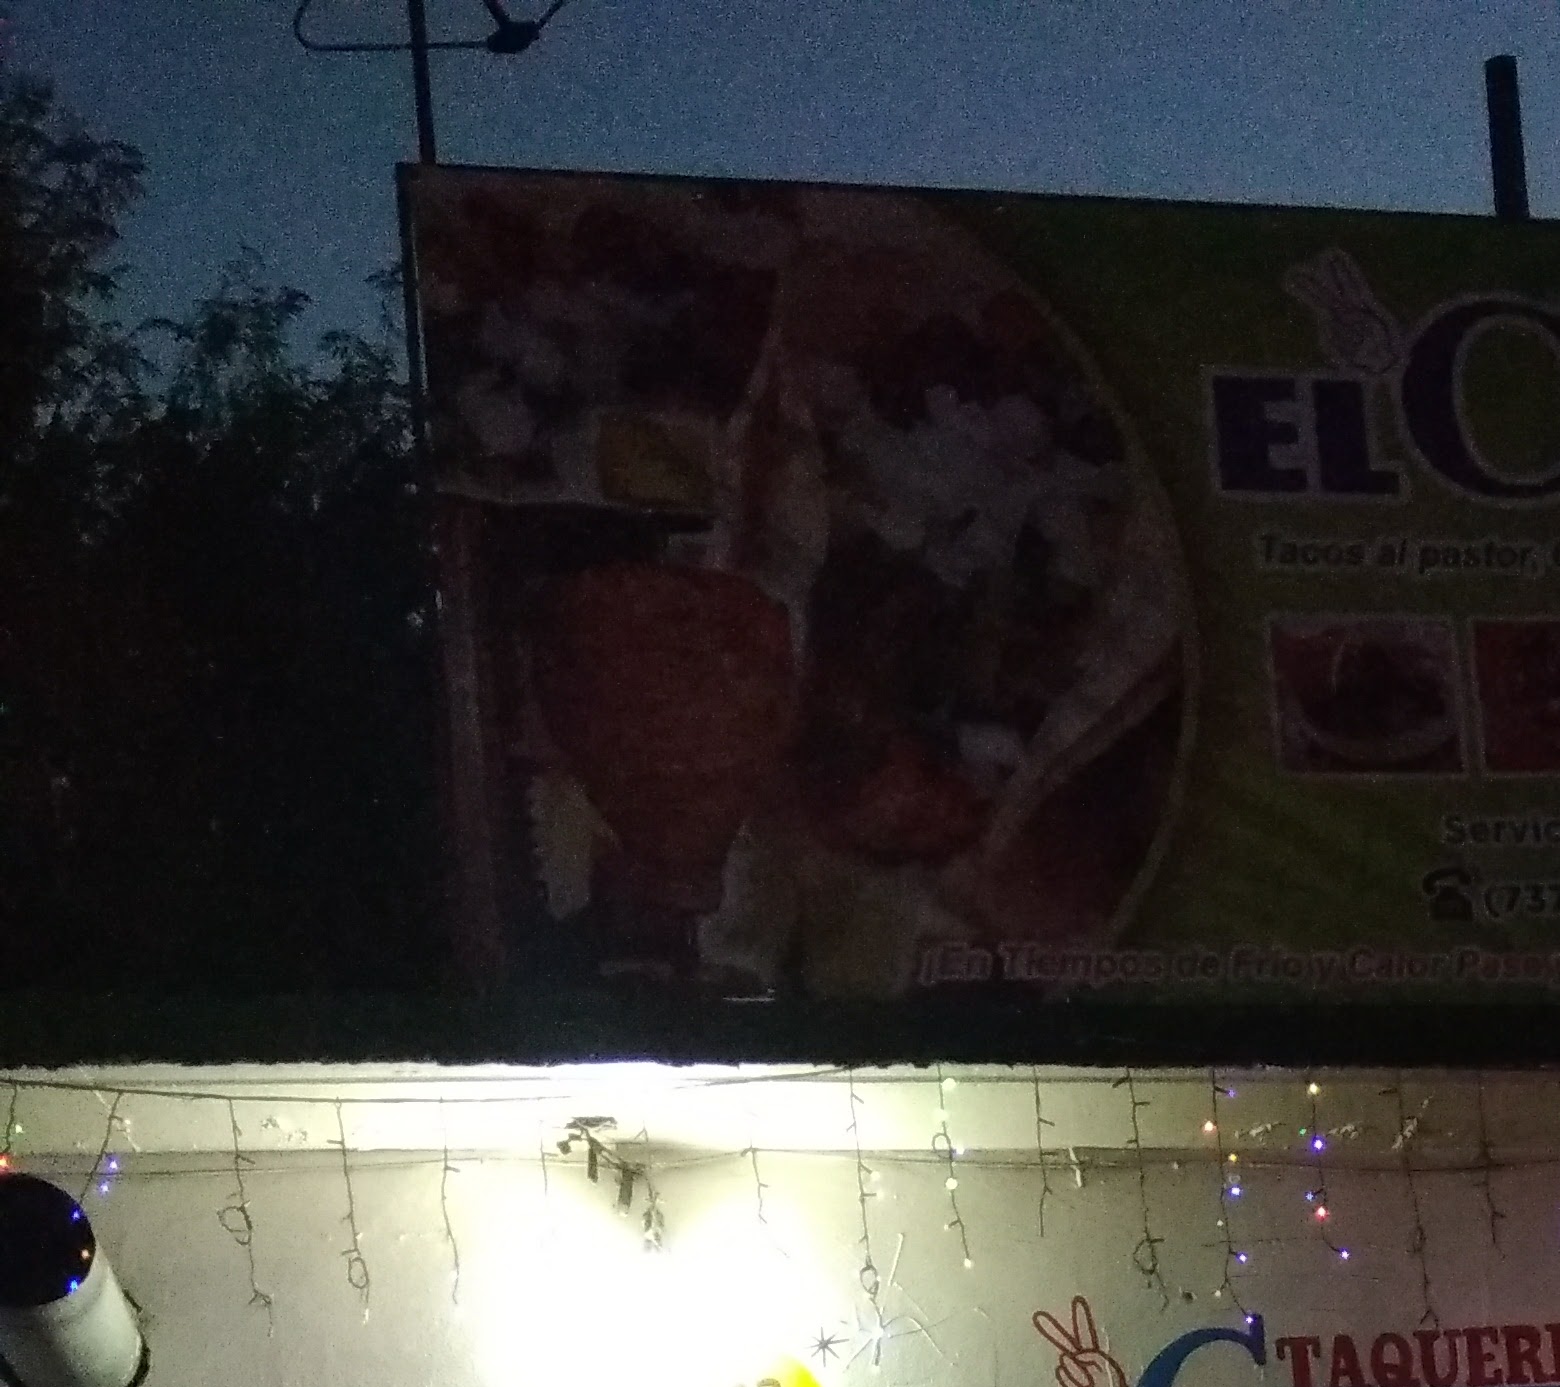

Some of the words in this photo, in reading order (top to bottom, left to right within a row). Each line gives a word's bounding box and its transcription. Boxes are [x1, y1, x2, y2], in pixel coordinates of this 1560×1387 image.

[1211, 375, 1401, 494] EL
[1259, 534, 1364, 567] Tacos
[1377, 538, 1407, 567] al
